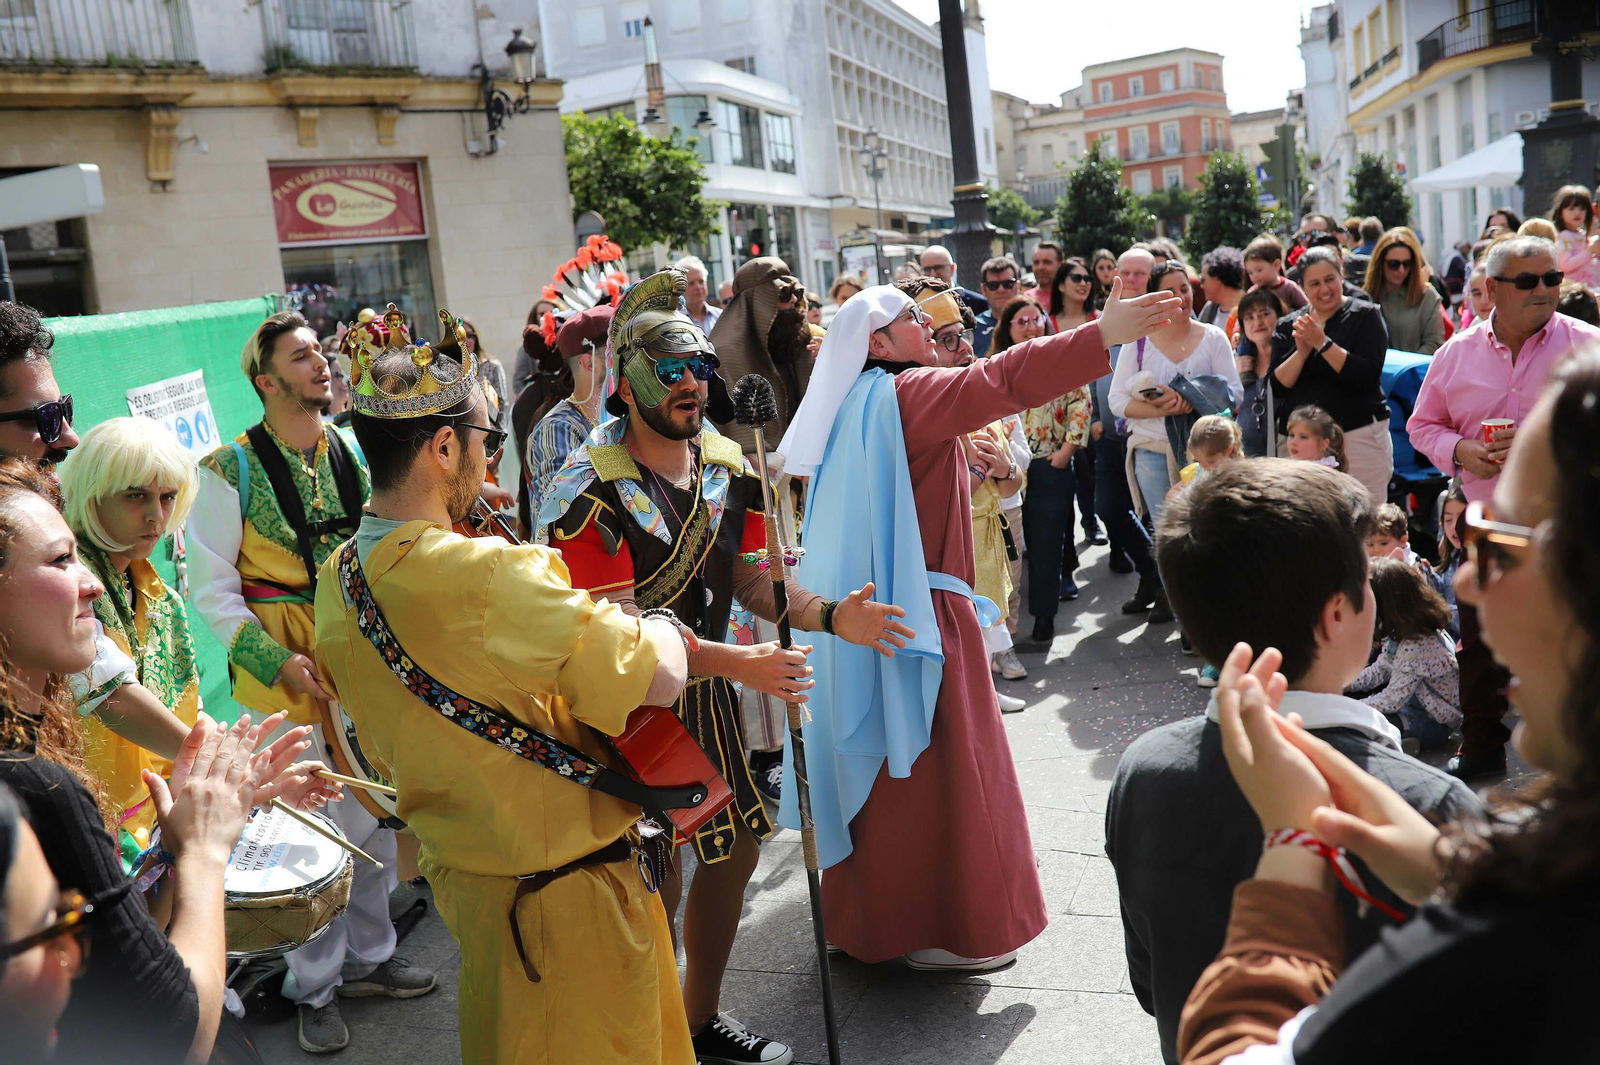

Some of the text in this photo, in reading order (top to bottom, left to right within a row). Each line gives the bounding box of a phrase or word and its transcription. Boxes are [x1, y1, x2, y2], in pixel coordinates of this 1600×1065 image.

[315, 201, 334, 213] La
[133, 396, 143, 408] ES
[259, 843, 275, 859] 902
[269, 827, 282, 843] 440
